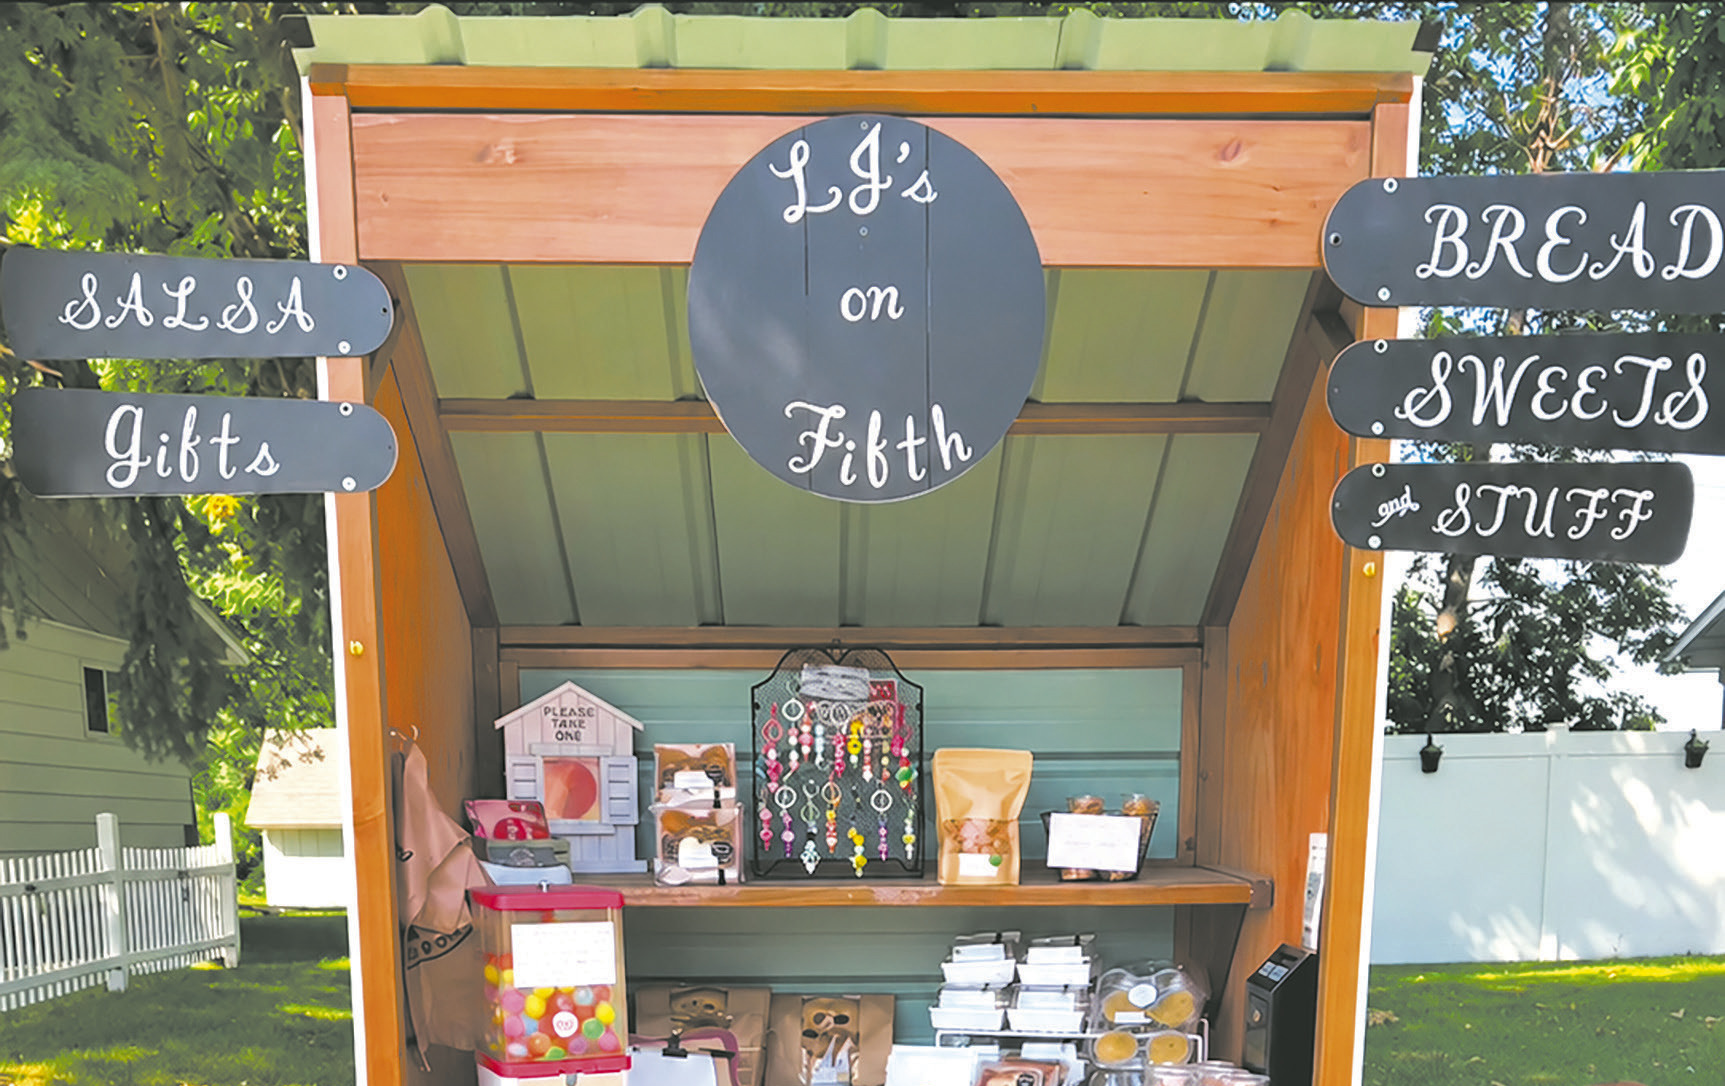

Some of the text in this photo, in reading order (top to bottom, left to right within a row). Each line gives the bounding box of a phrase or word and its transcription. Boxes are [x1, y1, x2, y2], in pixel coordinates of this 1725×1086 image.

[768, 122, 938, 224] LJ's
[1415, 201, 1724, 283] BREAD
[58, 271, 315, 335] SALSA
[840, 285, 905, 322] on
[1394, 351, 1709, 430] SWEETS
[784, 401, 973, 488] Fifth
[1371, 483, 1654, 540] and STUFF
[543, 706, 595, 717] PLEASE
[551, 718, 586, 729] TAKE
[555, 730, 582, 742] ONE
